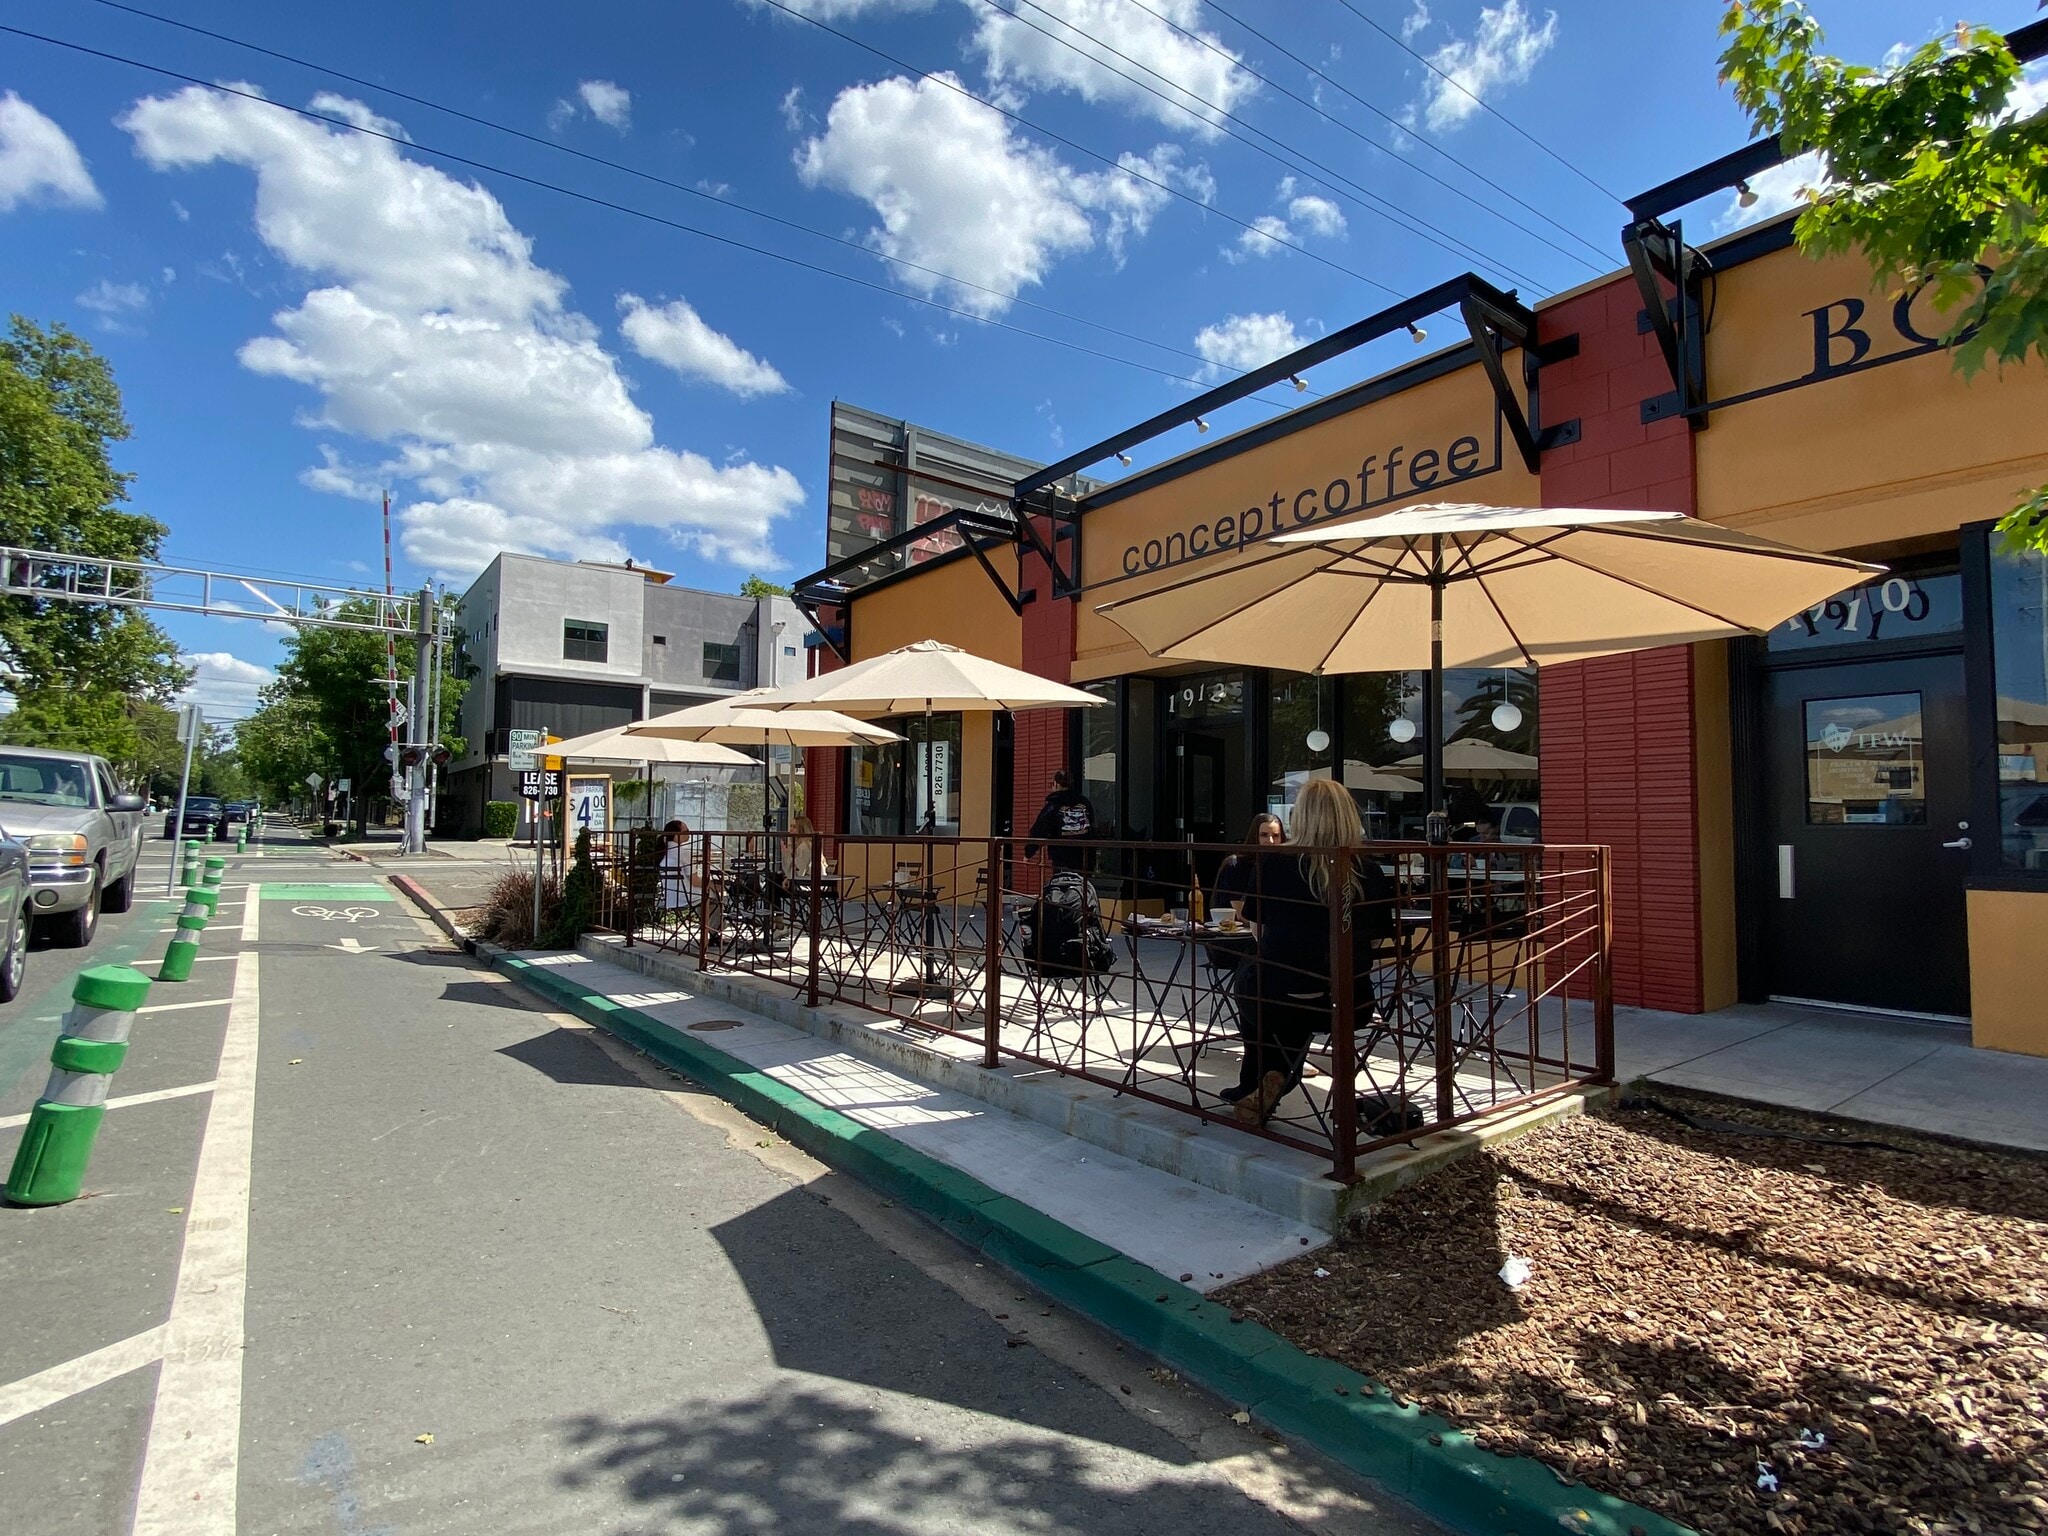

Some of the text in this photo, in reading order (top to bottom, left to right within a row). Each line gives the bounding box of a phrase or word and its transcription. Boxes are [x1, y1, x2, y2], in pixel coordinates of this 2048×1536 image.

[511, 731, 521, 740] 90
[1857, 731, 1907, 749] TFW
[935, 746, 944, 796] 826.7730
[523, 786, 558, 795] 826-730
